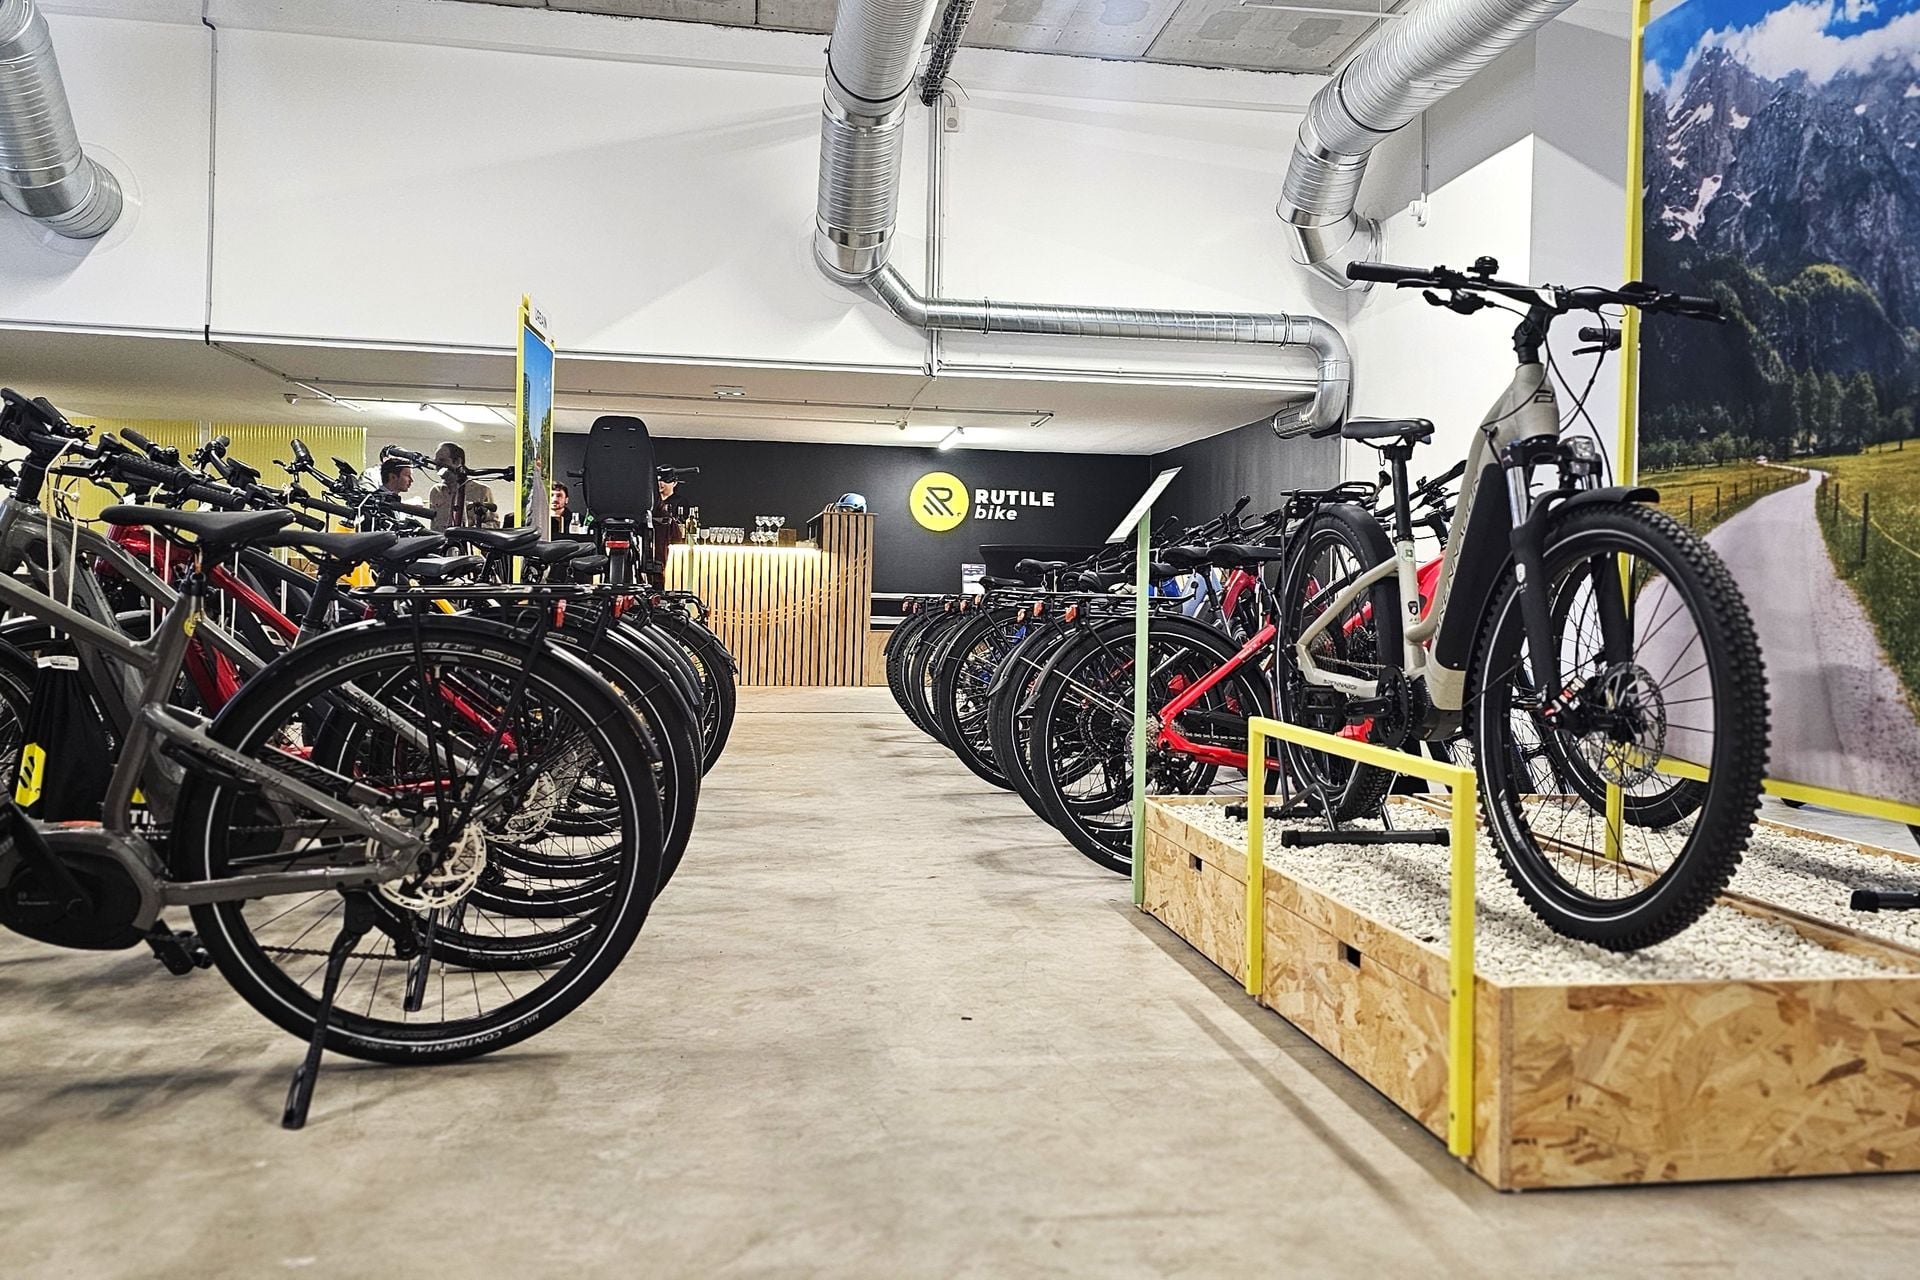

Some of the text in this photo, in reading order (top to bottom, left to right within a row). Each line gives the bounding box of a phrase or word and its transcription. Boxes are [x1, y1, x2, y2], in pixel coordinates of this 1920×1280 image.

[974, 488, 1055, 507] RUTILE
[974, 505, 1018, 521] bike
[262, 753, 344, 786] ONWAY
[410, 1030, 503, 1053] CONTINENTAL
